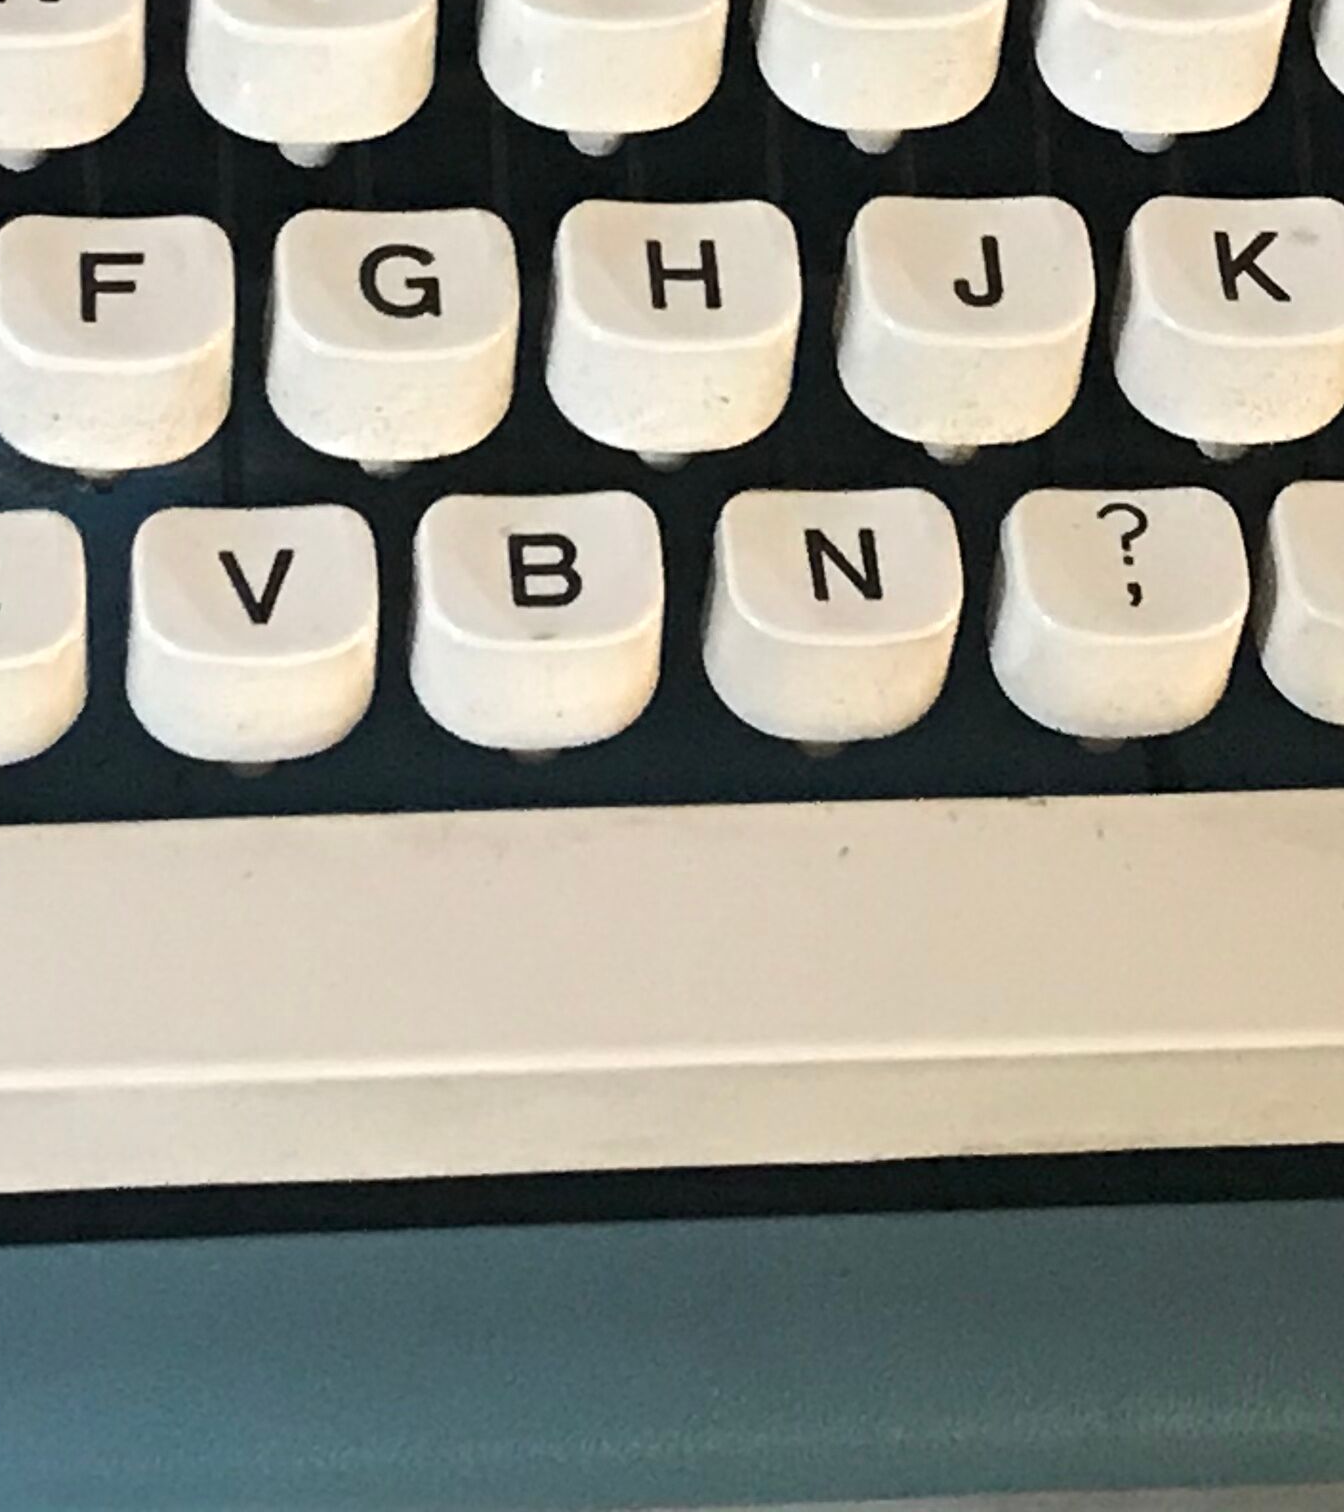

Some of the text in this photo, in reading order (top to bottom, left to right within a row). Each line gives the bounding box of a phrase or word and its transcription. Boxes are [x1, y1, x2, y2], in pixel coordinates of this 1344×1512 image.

[78, 251, 146, 324] F
[357, 243, 443, 320] G
[645, 238, 723, 311] H
[952, 234, 1005, 309] J
[1213, 230, 1292, 303] K
[506, 532, 584, 609] B
[803, 527, 884, 603] N
[1095, 501, 1149, 567] ?
[217, 548, 295, 626] V
